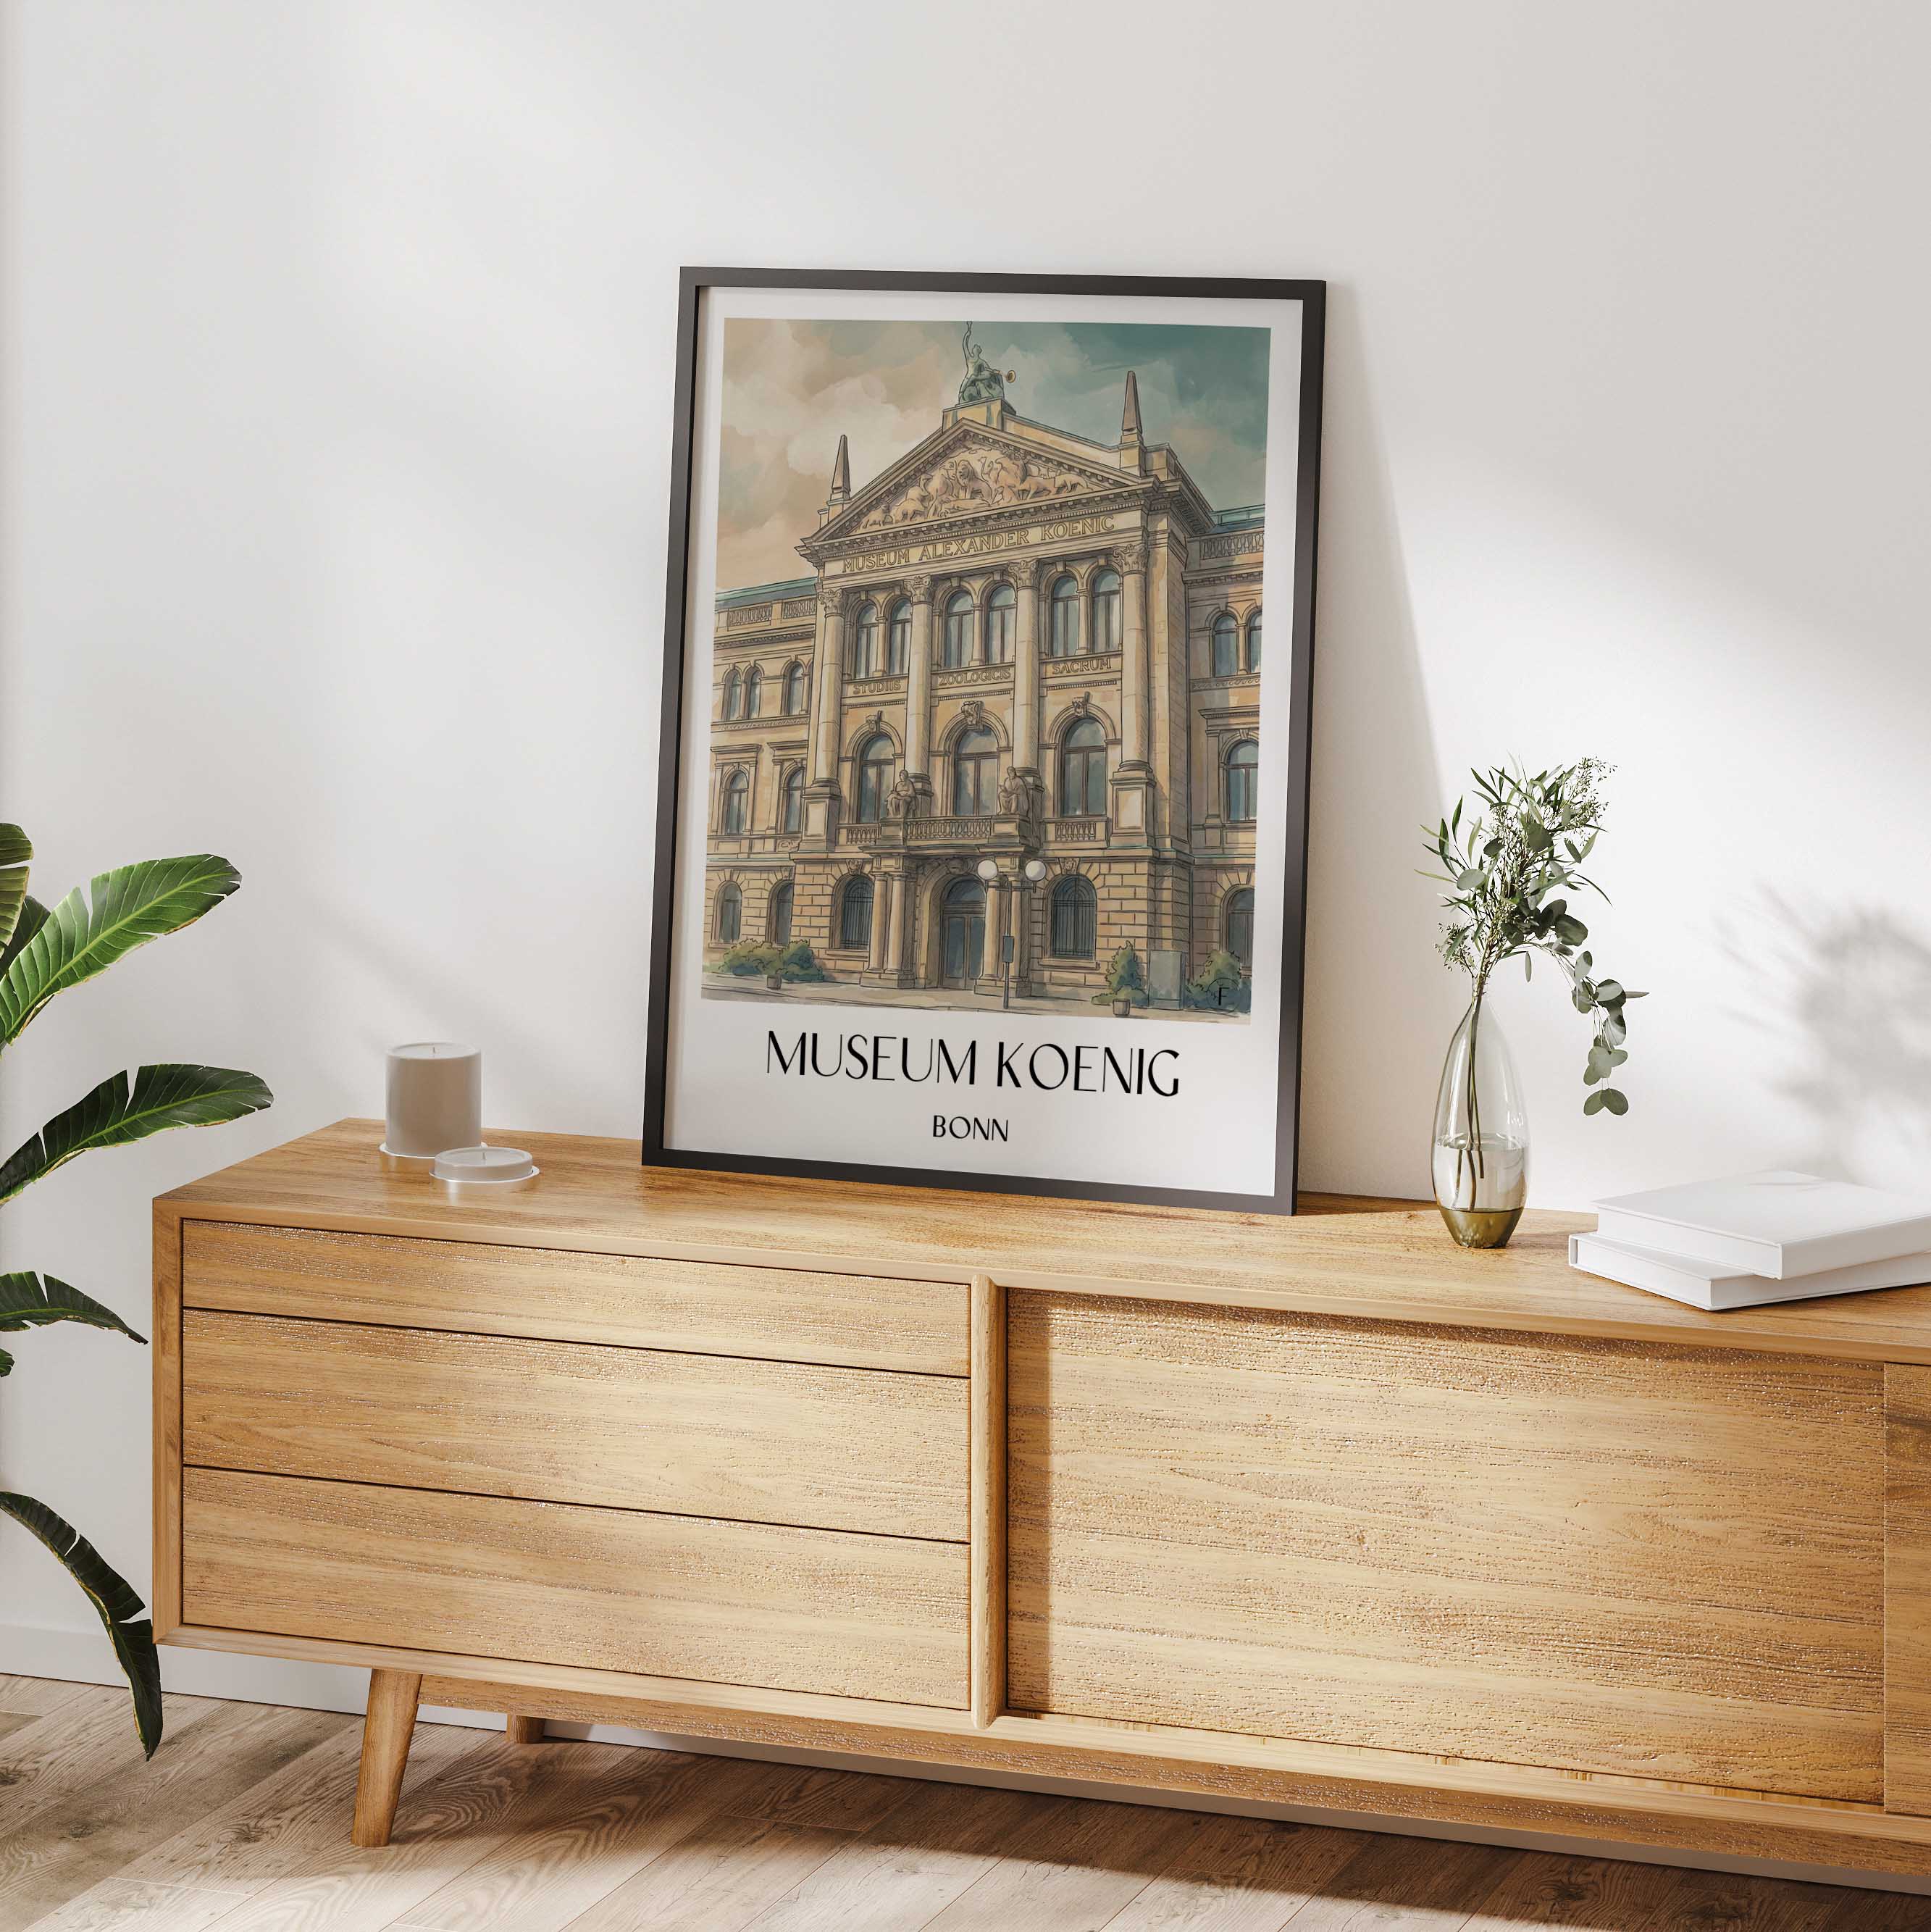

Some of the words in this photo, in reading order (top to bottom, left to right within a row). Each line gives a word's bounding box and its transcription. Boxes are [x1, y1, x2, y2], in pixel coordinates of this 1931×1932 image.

[842, 548, 910, 573] MUSEUM
[918, 530, 1031, 561] ALEXANDER
[1052, 657, 1112, 674] SACRUM
[767, 1031, 976, 1085] MUSEUM
[997, 1042, 1180, 1097] KOENIG
[932, 1116, 1009, 1142] BONN
